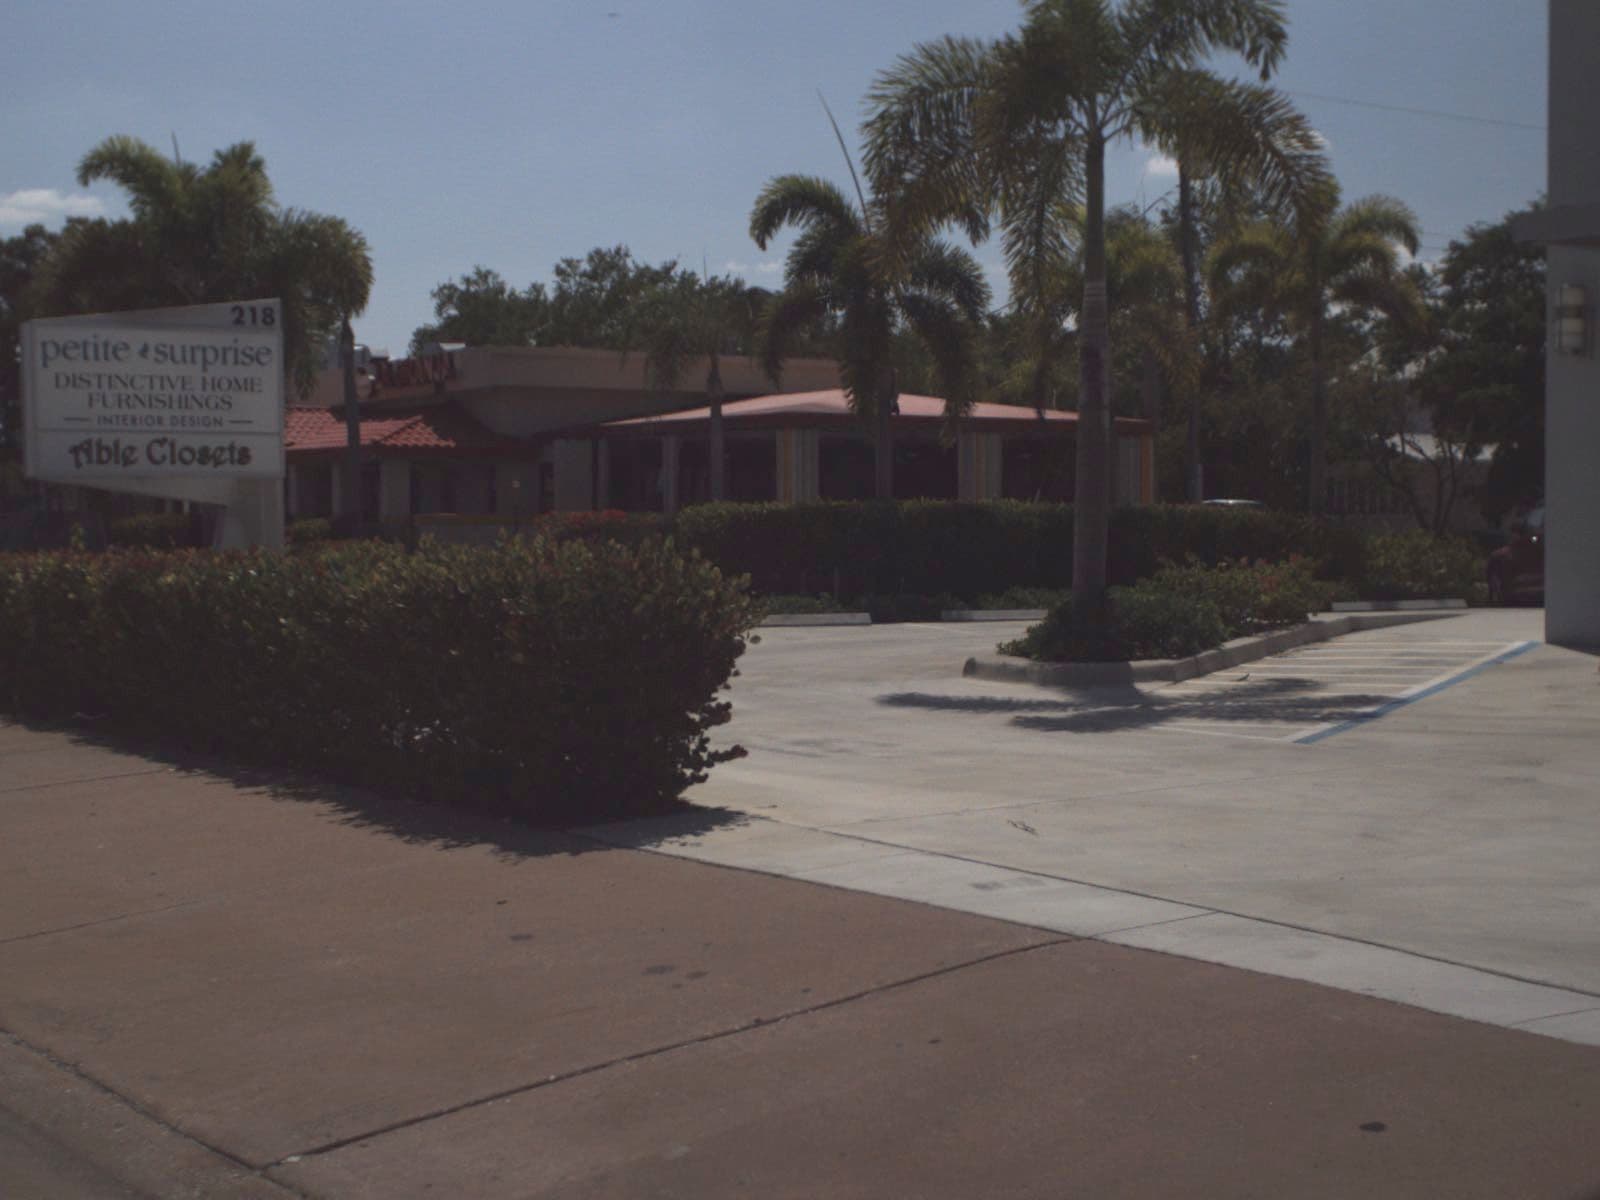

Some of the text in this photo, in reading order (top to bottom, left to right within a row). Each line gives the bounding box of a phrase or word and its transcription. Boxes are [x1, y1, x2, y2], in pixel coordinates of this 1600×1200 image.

[231, 305, 275, 326] 218
[40, 335, 272, 371] petite surprise
[54, 373, 263, 393] DISTINCTIVE HOME
[87, 393, 233, 410] FURNISHINGS
[97, 415, 223, 427] INTERIOR DESIGN
[69, 437, 251, 468] Able Closets
